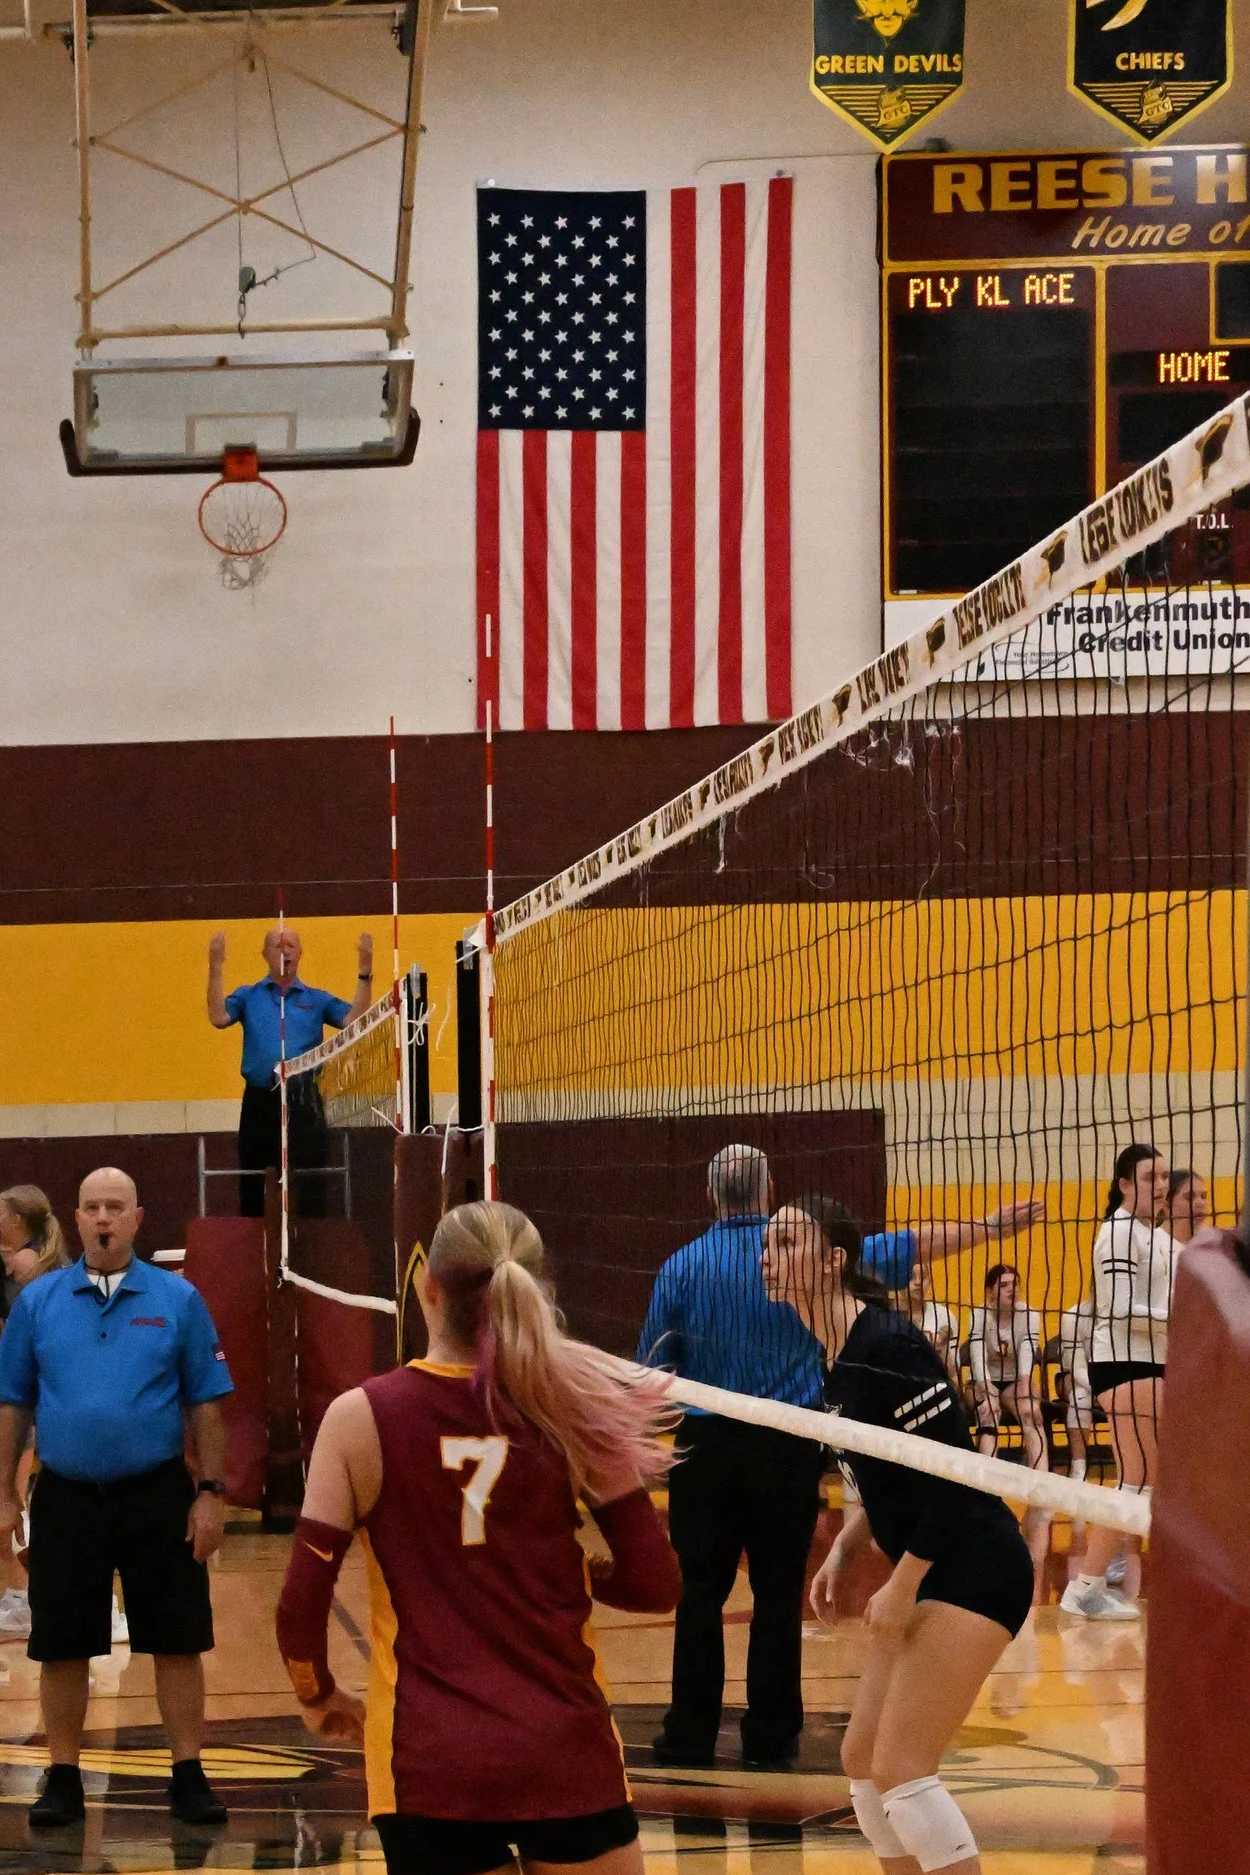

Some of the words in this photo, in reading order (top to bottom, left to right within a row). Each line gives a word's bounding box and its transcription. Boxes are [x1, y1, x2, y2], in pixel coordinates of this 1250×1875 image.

[815, 54, 884, 75] GREEN
[894, 52, 963, 74] DEVILS
[1115, 52, 1185, 71] CHIEFS
[933, 156, 1174, 213] REESE
[1071, 215, 1191, 250] Home
[908, 277, 958, 309] PLY
[976, 275, 1010, 307] KL
[1024, 273, 1075, 305] ACE
[1159, 351, 1231, 383] HOME
[1048, 595, 1250, 626] Frankenmuth
[1078, 630, 1163, 654] Credit
[1173, 629, 1250, 651] Union
[440, 1436, 509, 1546] 7
